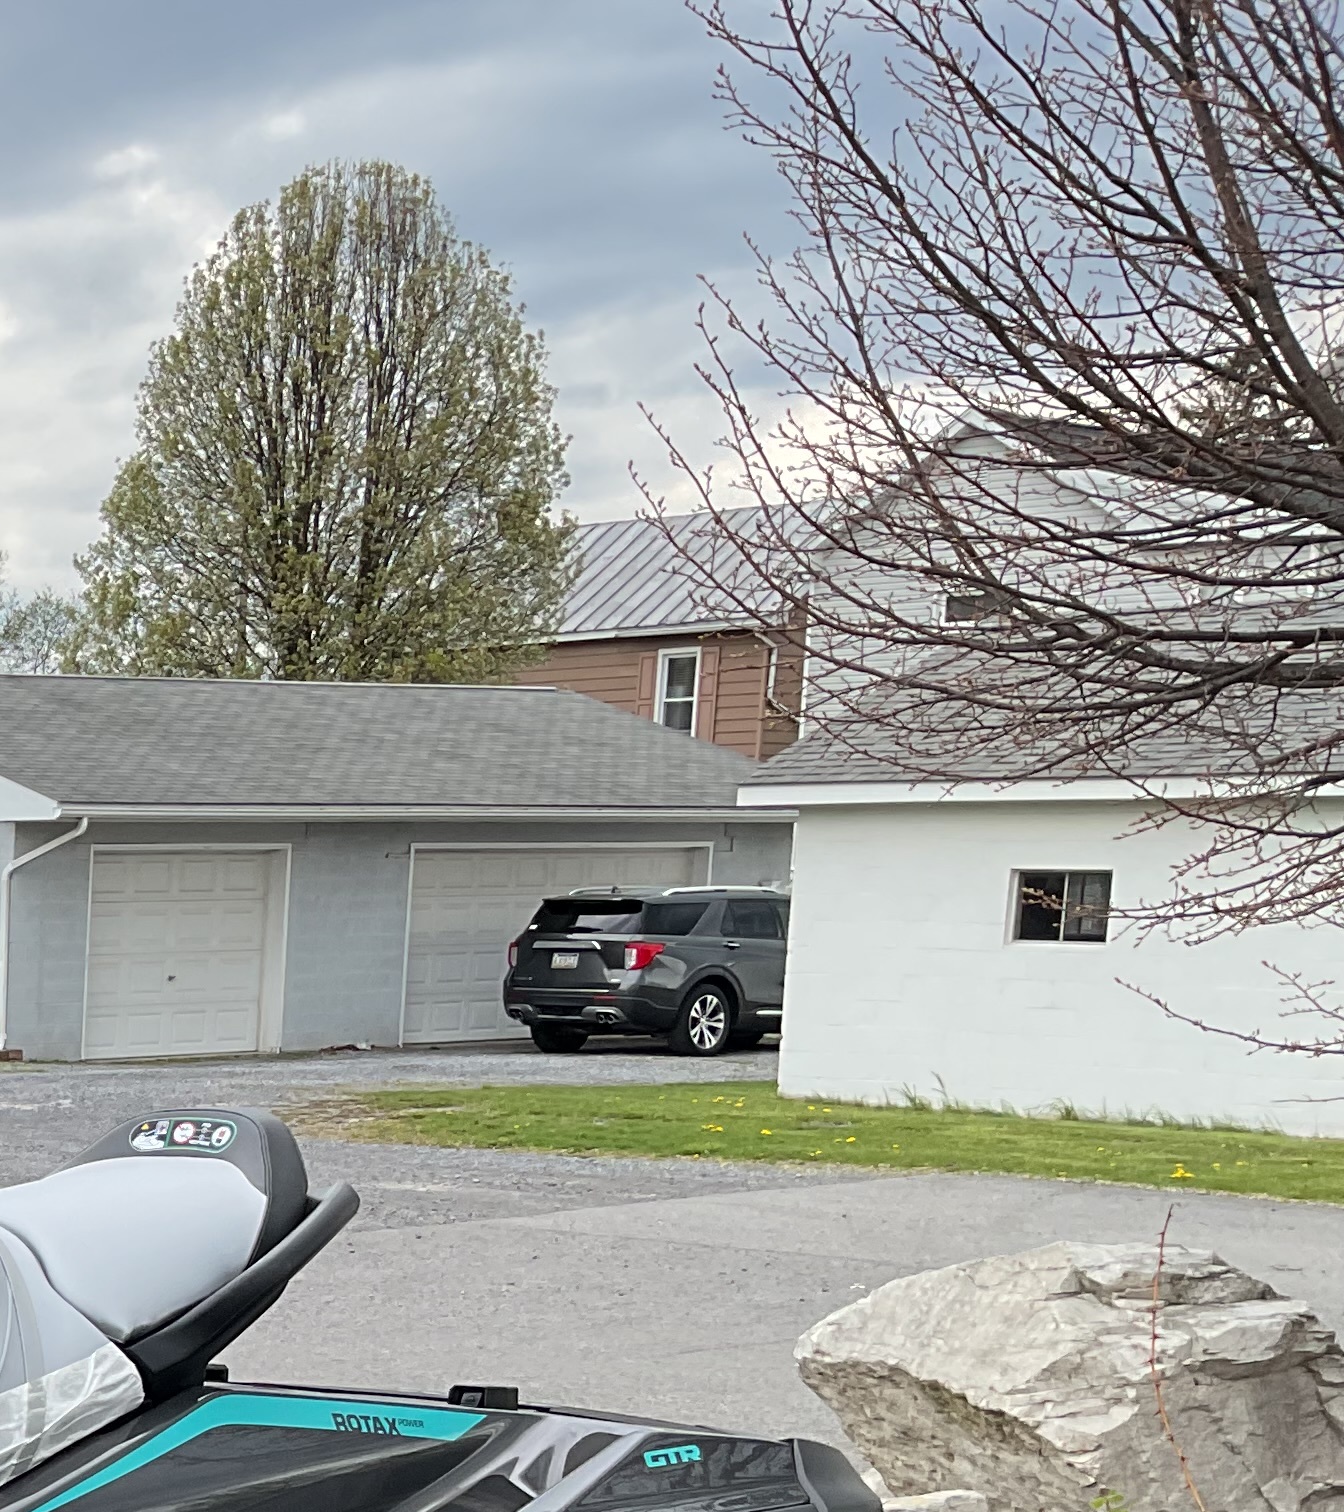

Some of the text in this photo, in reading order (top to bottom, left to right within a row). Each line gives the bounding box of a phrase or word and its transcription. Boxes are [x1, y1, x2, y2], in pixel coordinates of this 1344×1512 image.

[331, 1412, 425, 1436] ROTAX POWER
[643, 1444, 702, 1468] GTR
